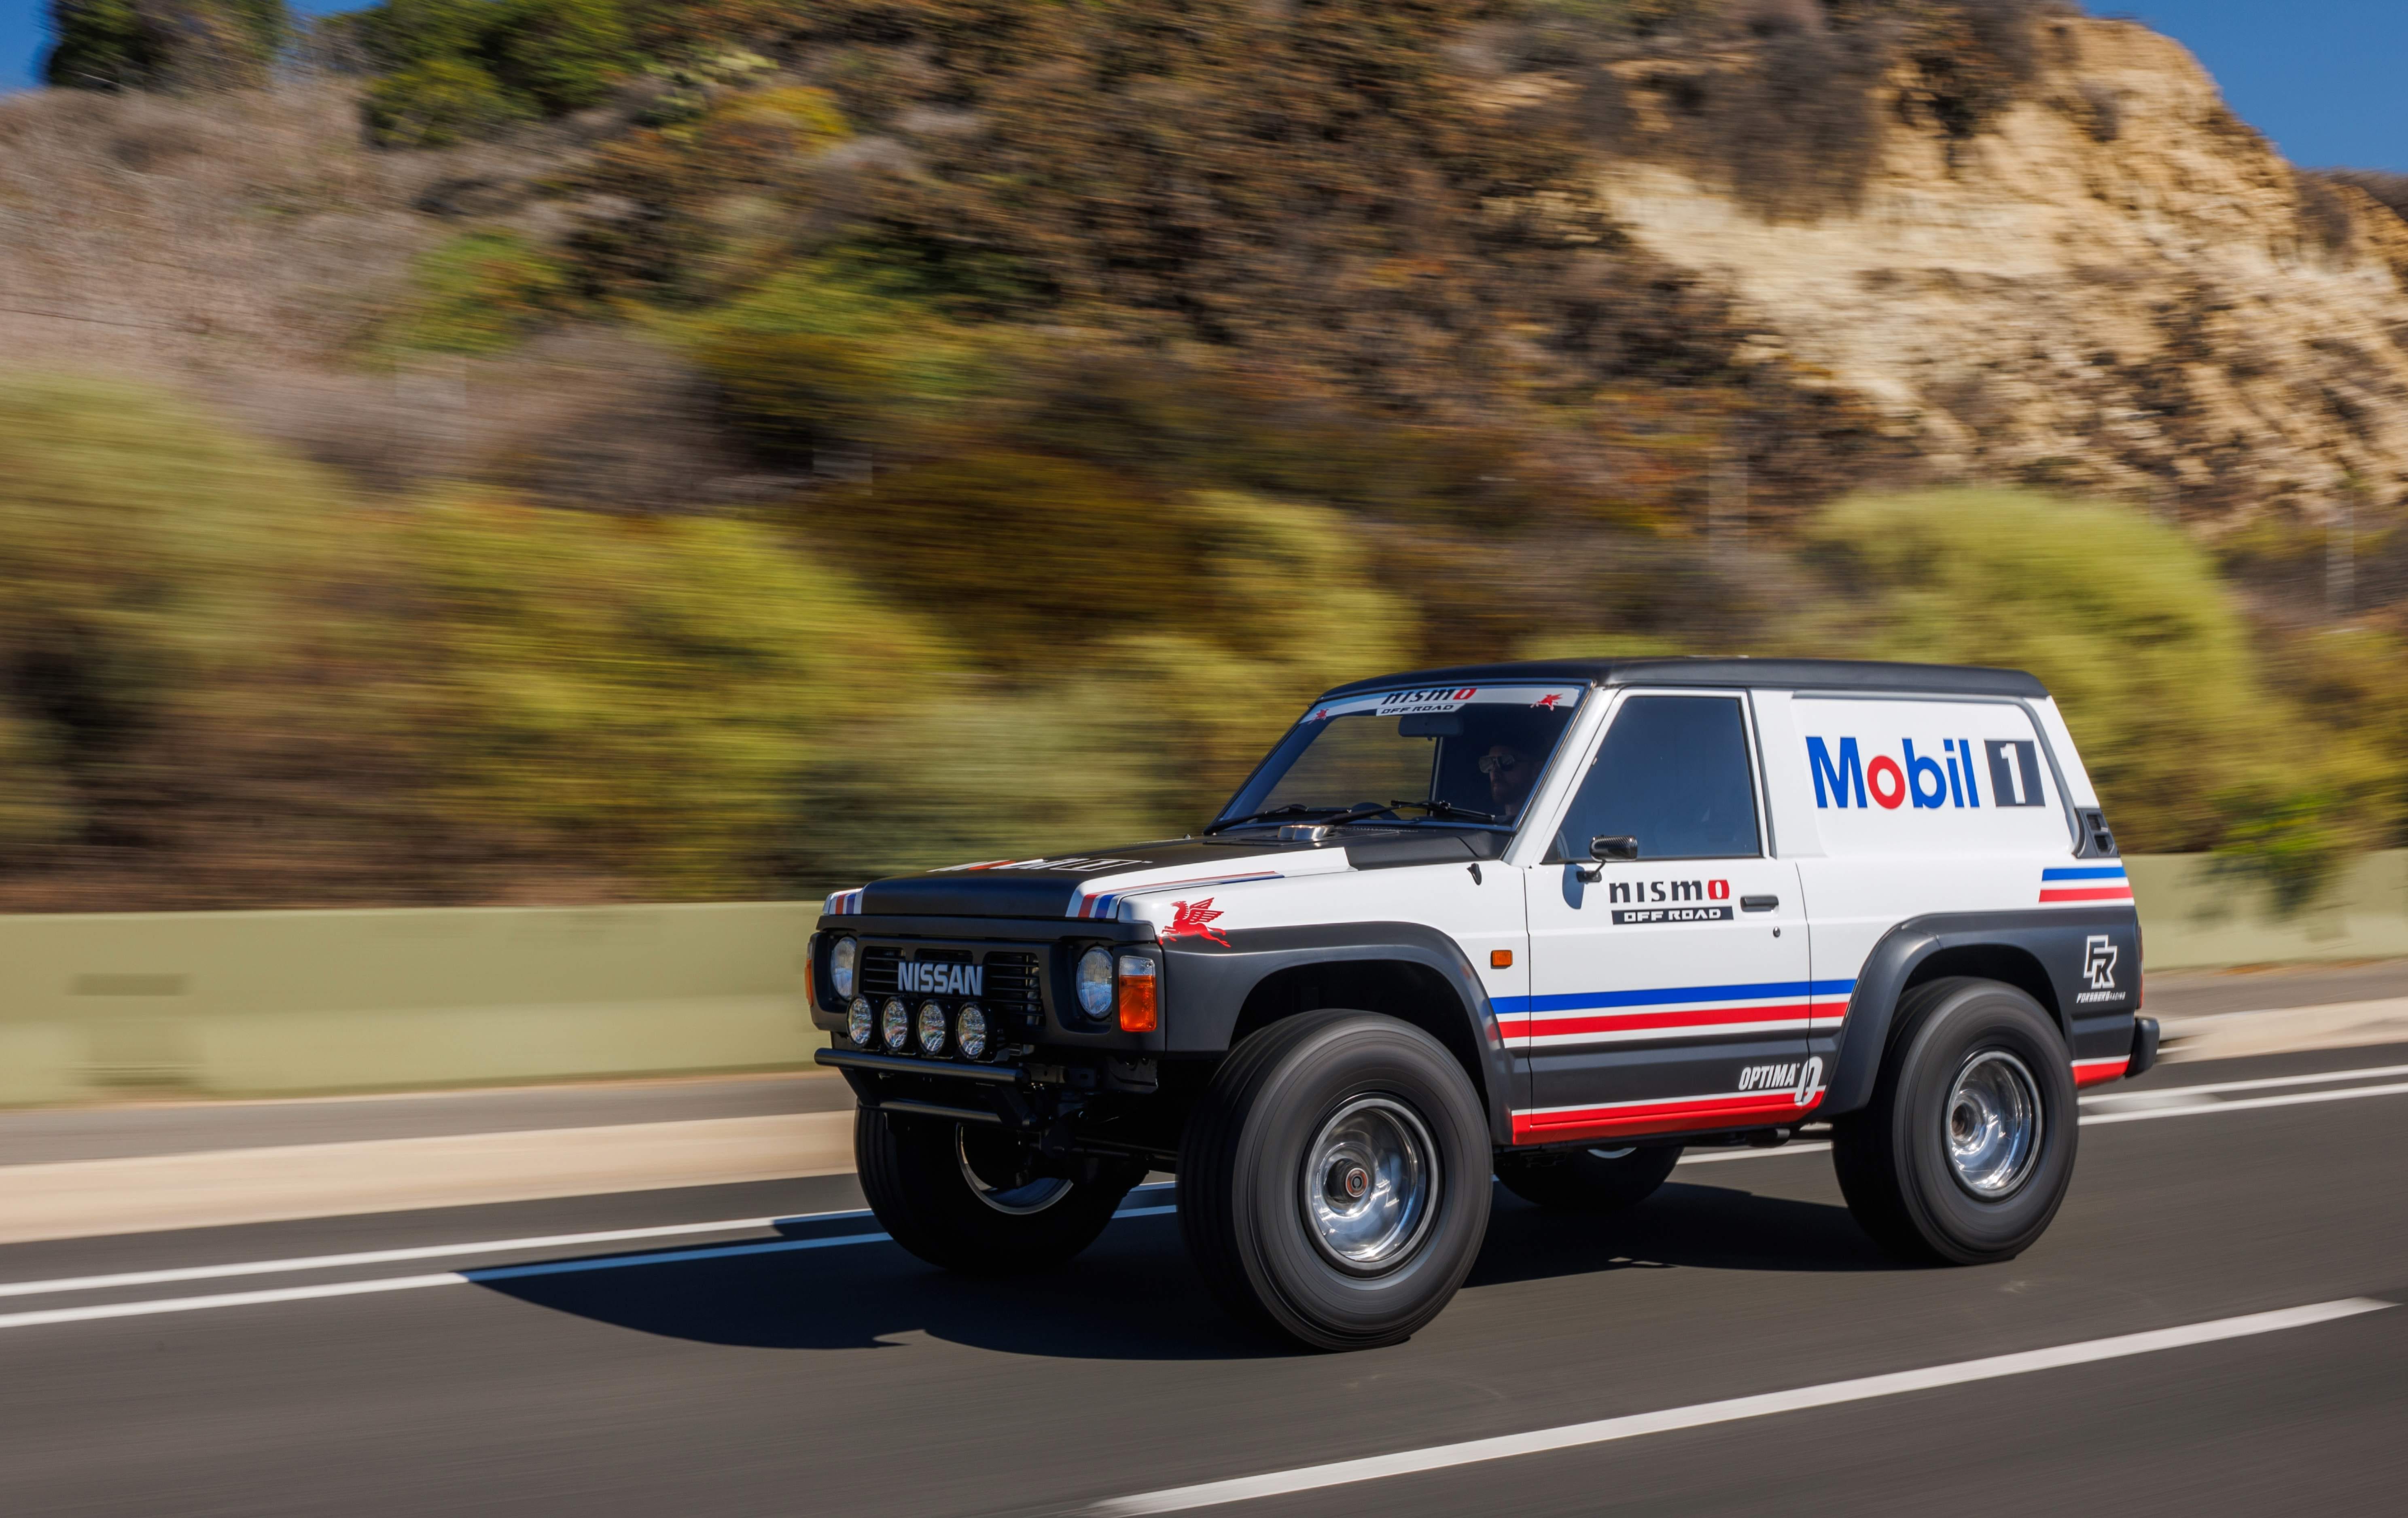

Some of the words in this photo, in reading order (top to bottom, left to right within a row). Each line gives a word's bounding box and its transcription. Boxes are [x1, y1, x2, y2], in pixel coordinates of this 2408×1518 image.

[1805, 736, 1980, 809] Mobil
[2000, 743, 2026, 804] 1
[1624, 910, 1663, 922] OFF
[1668, 908, 1721, 921] ROAD
[898, 962, 983, 996] NISSAN
[1738, 1063, 1796, 1090] OPTIMA
